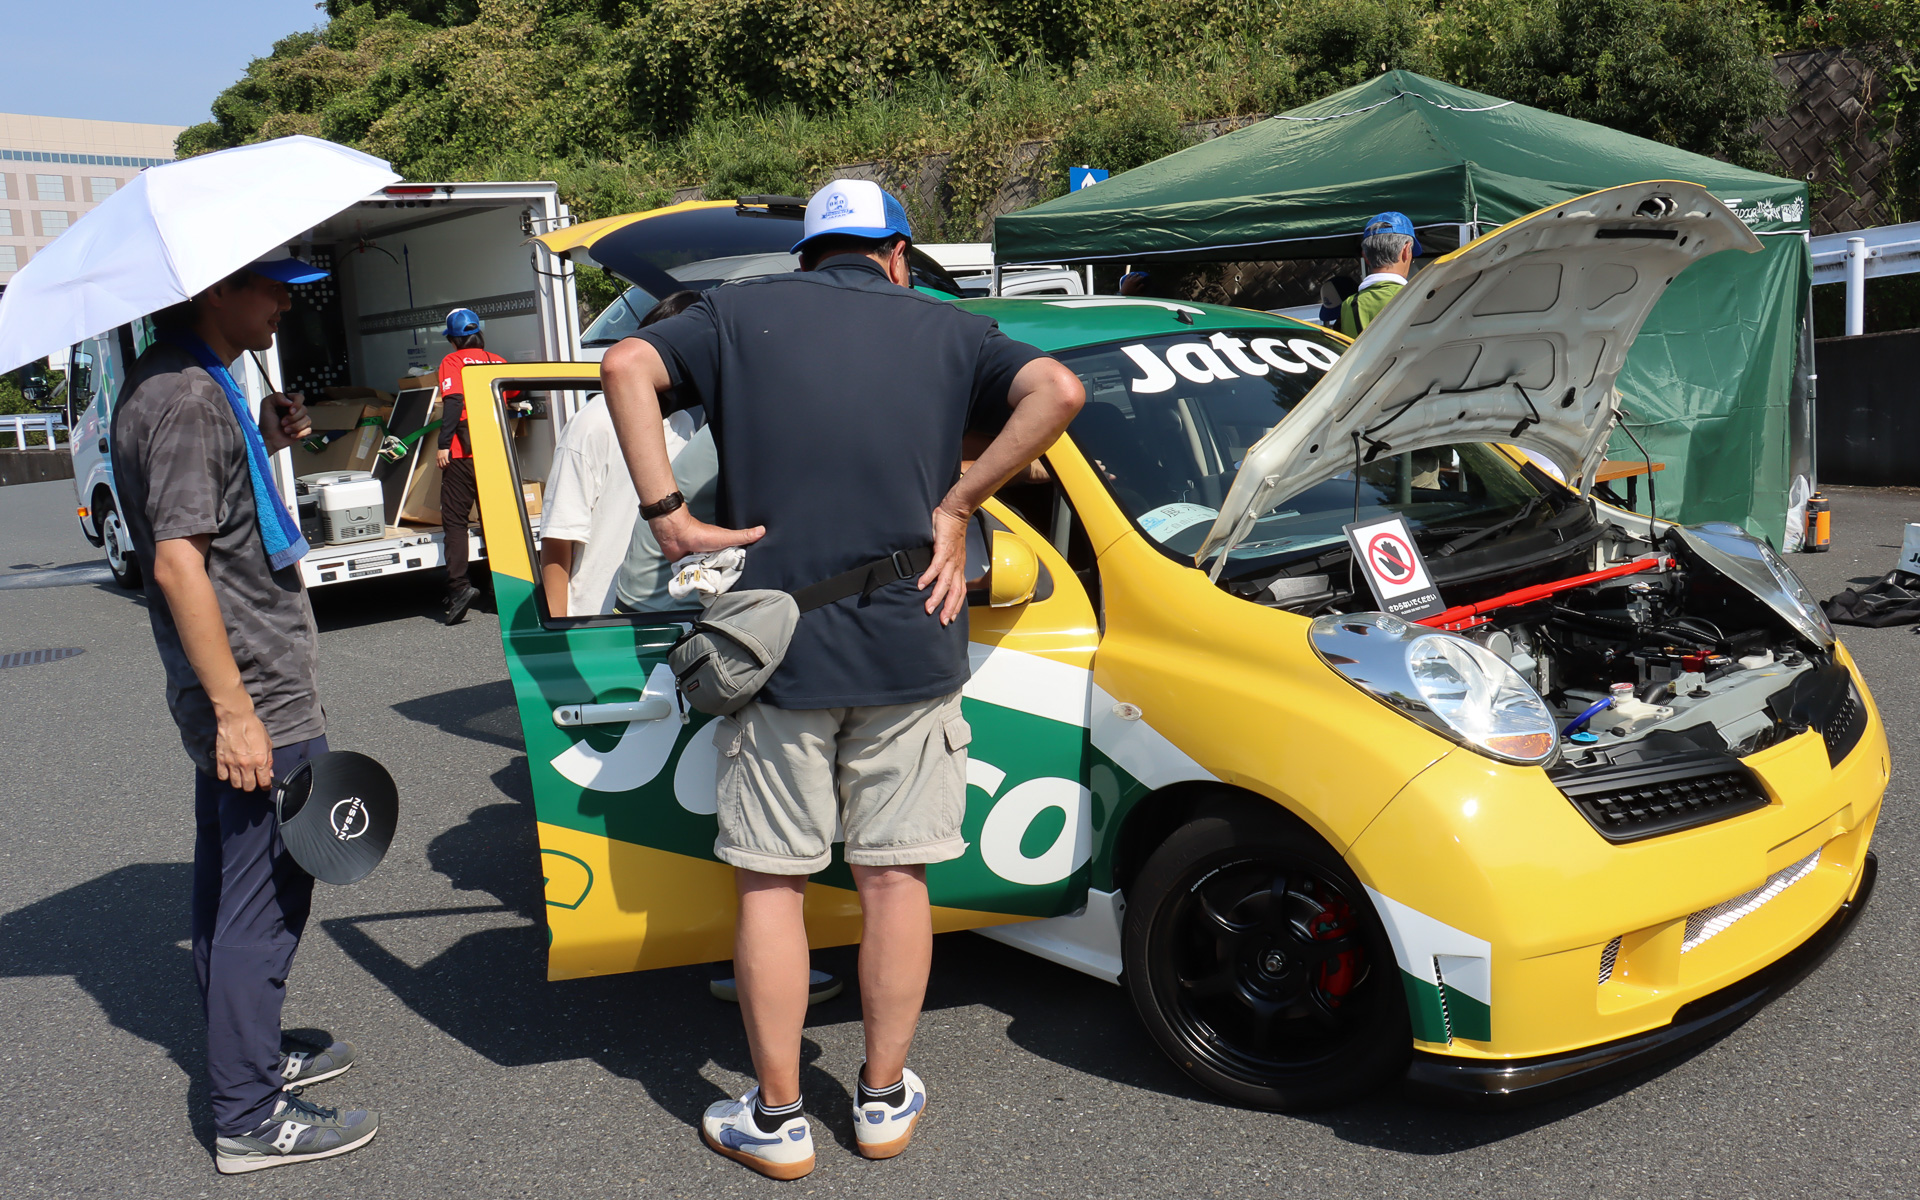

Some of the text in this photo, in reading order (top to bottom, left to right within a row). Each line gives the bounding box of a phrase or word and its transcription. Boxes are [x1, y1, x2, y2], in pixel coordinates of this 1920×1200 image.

[1120, 332, 1340, 393] Jatco
[1388, 594, 1437, 612] さわらないでください
[338, 797, 361, 840] NISSAN
